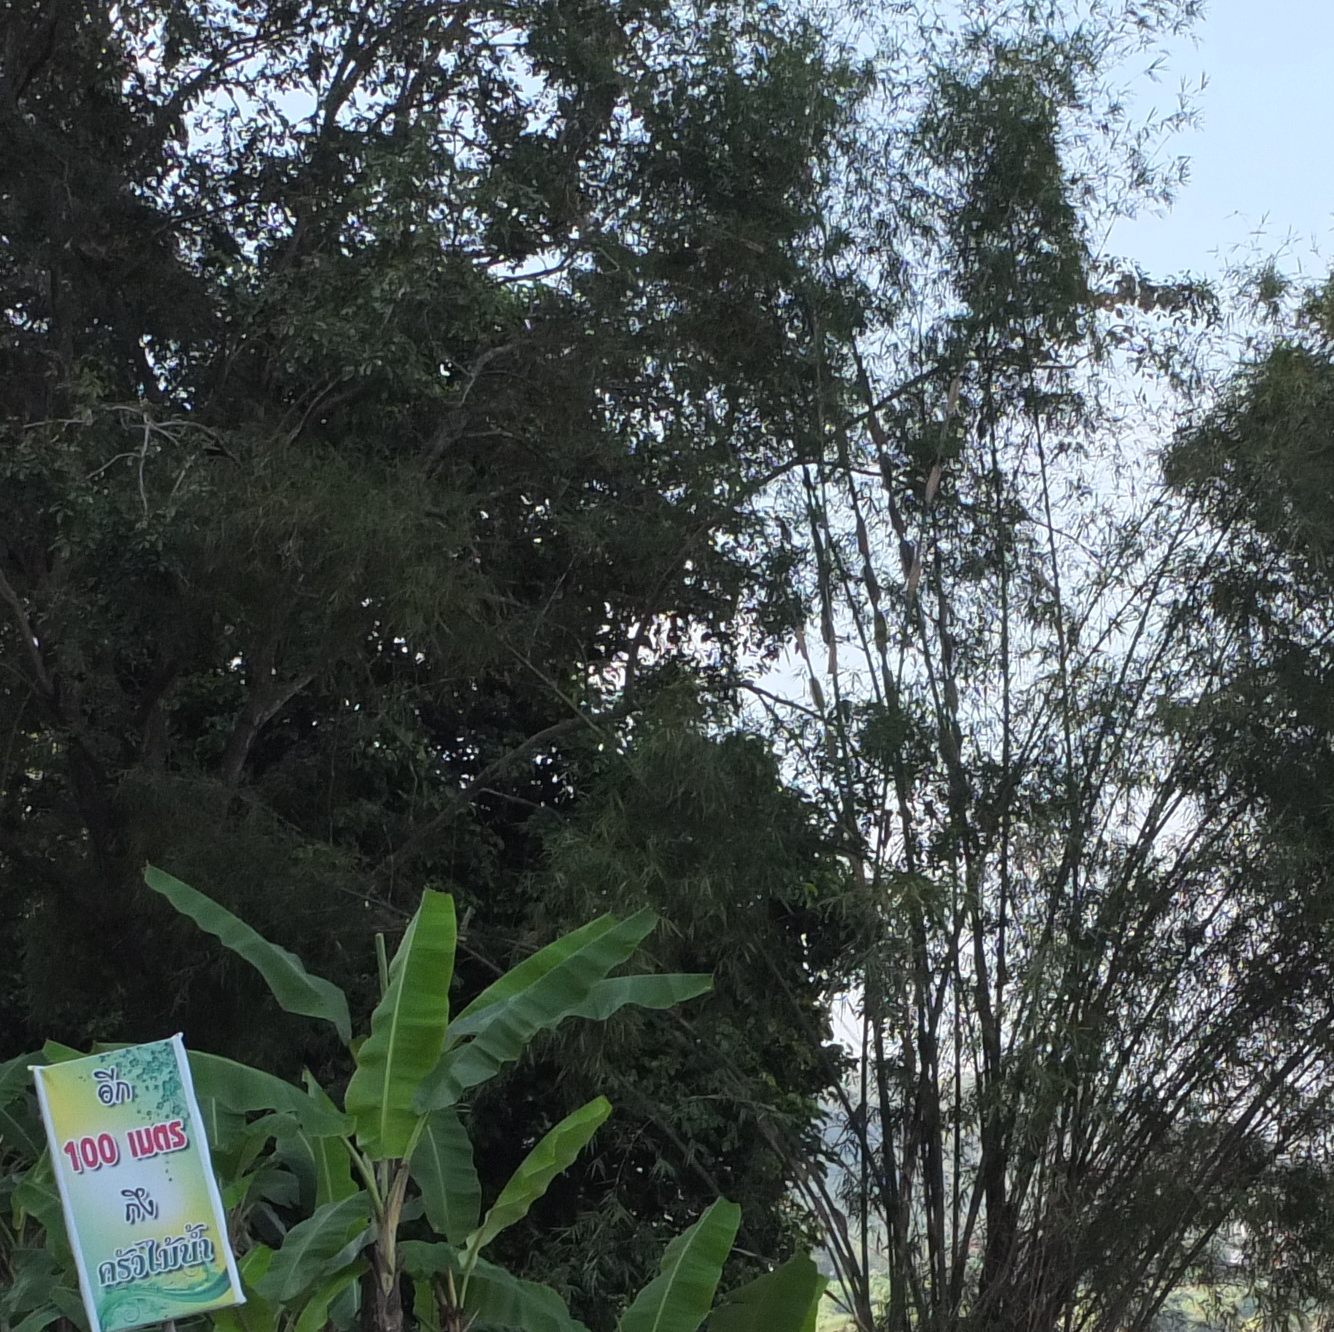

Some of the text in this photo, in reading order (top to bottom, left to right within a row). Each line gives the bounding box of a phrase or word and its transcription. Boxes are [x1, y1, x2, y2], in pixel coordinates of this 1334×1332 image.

[93, 1067, 131, 1104] อีก
[64, 1120, 186, 1171] 100 เมตร
[98, 1223, 212, 1285] ครัวไม้น้ำ
